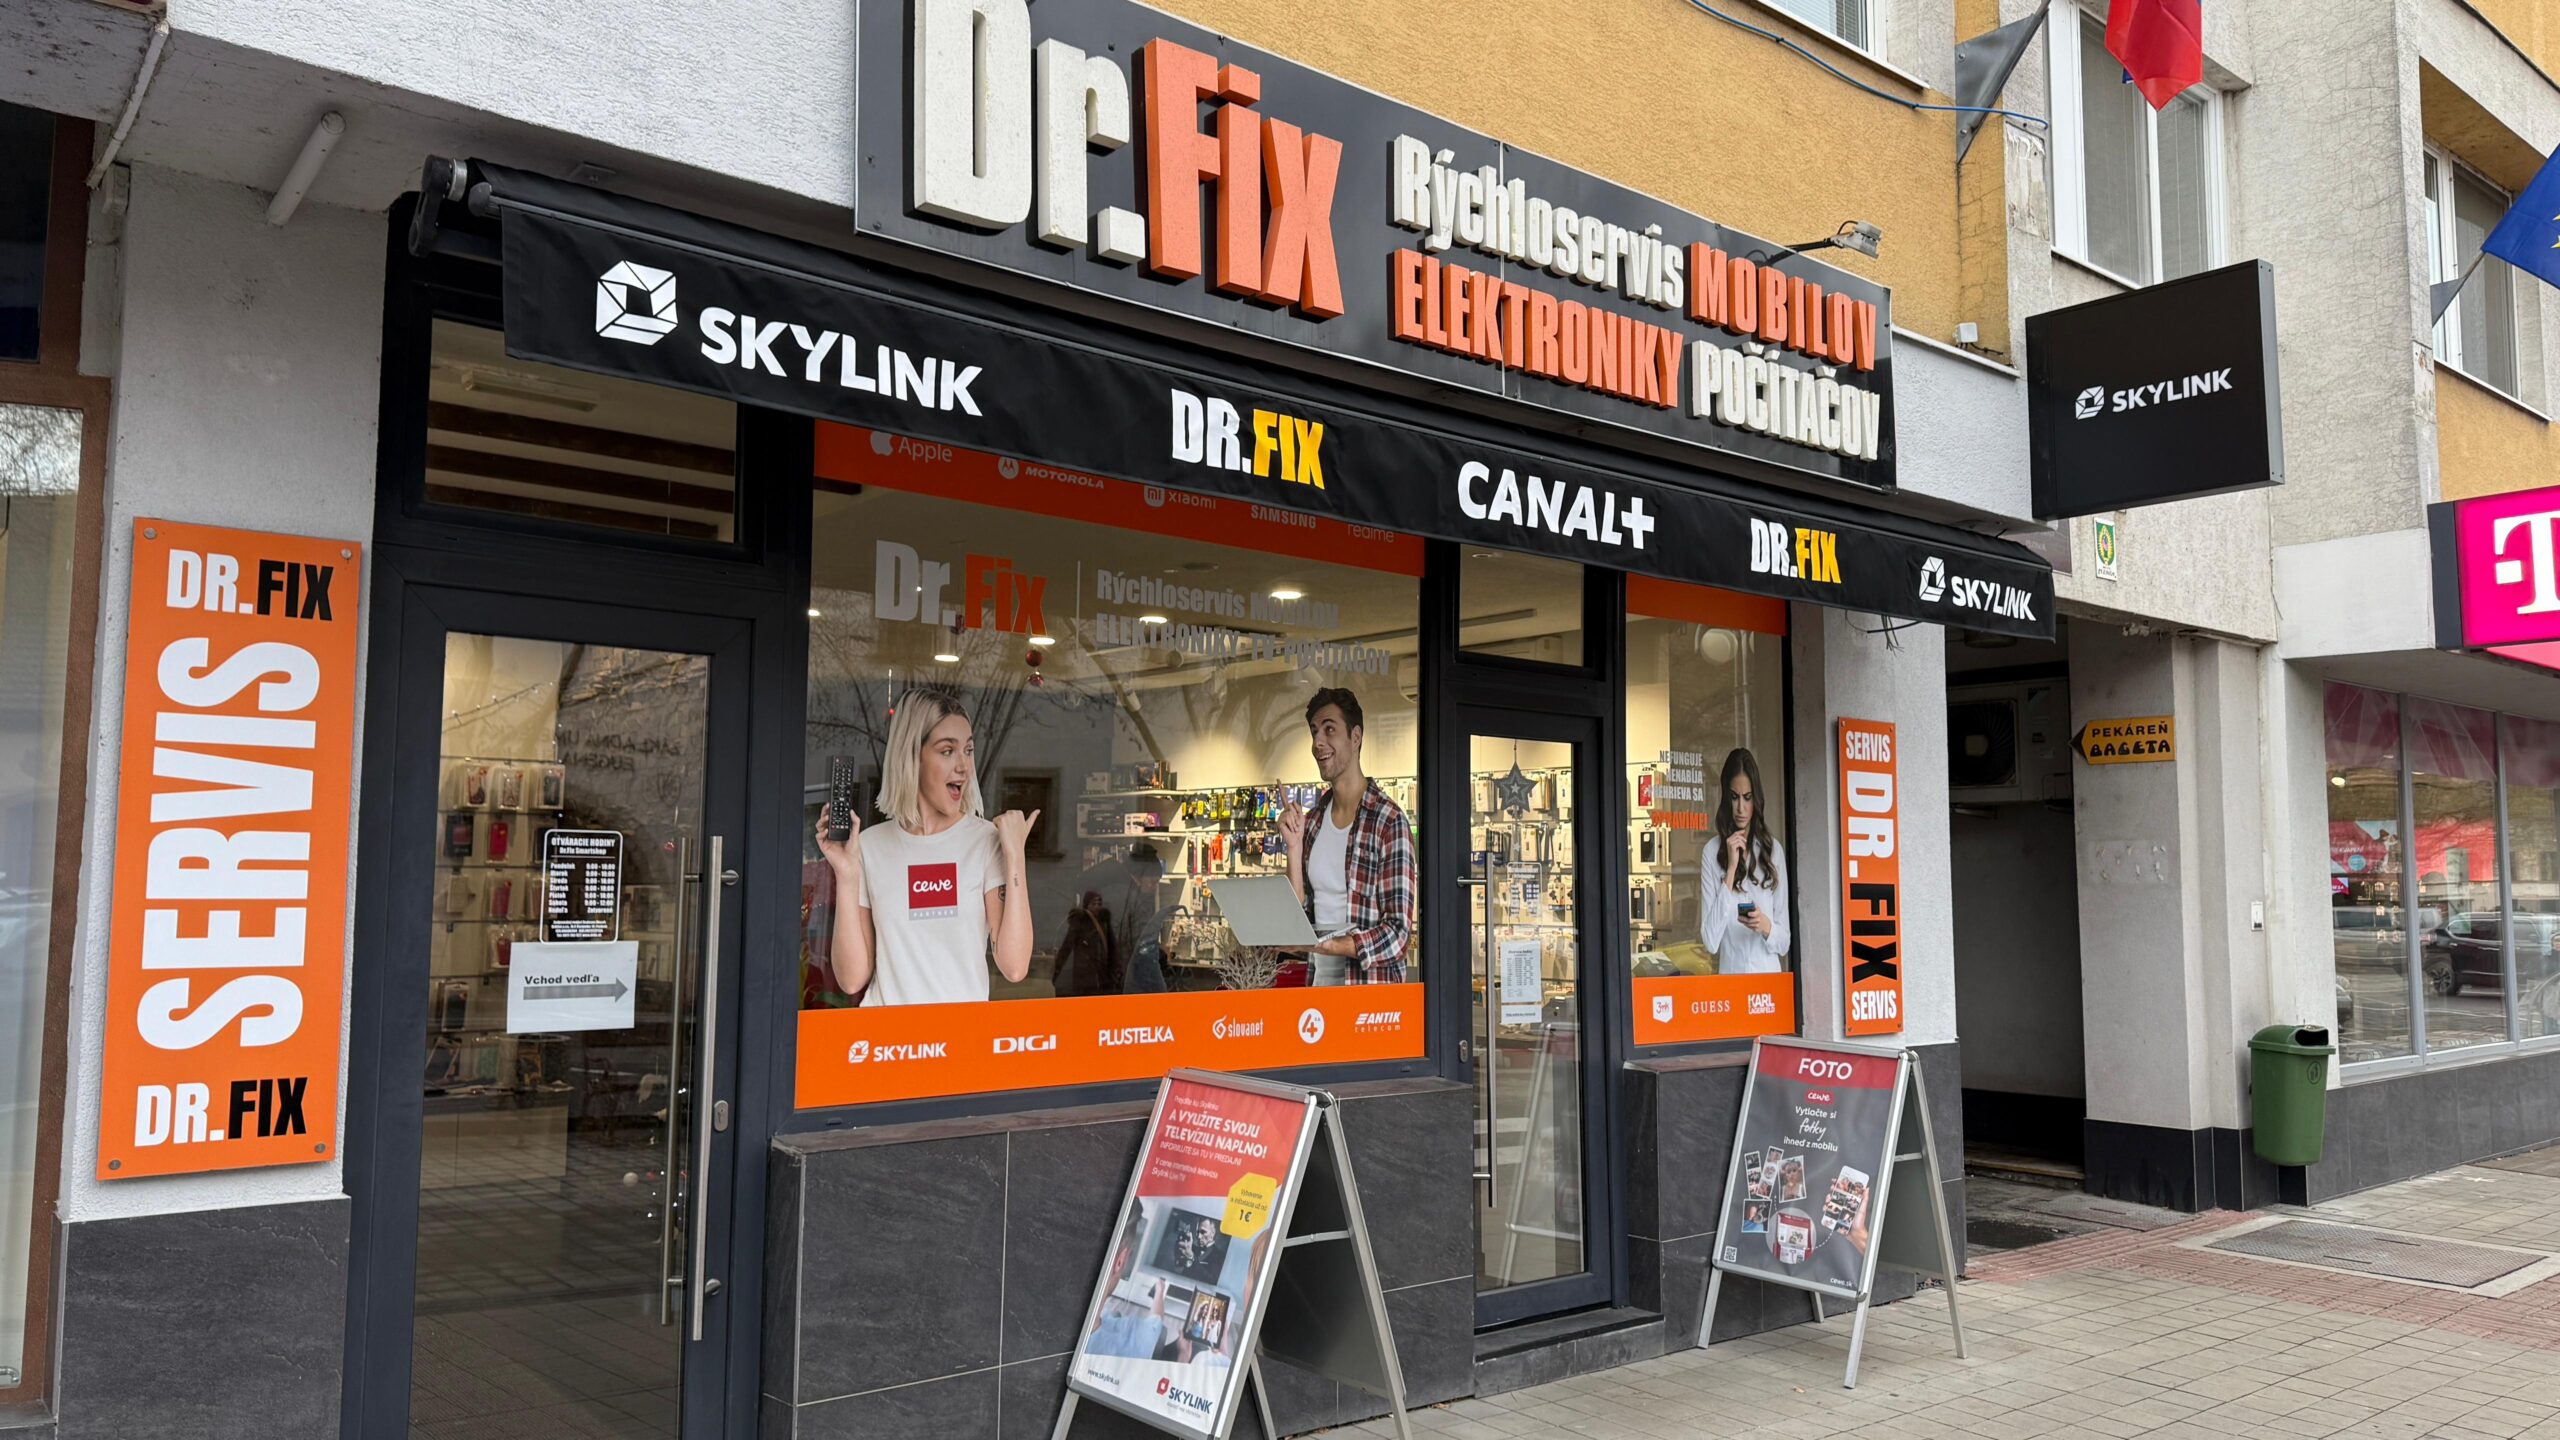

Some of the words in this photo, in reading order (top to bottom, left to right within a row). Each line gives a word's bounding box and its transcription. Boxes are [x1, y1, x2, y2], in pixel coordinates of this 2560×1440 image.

[914, 0, 1344, 319] Dr.Fix
[1393, 133, 1684, 310] Rýchloservis
[1689, 241, 1876, 372] MOBILOV
[699, 306, 983, 416] SKYLINK
[1393, 247, 1684, 409] ELEKTRONIKY
[1692, 339, 1880, 462] POČÍTAČOV
[2111, 367, 2233, 413] SKYLINK
[900, 437, 953, 463] Apple
[1171, 388, 1325, 490] DR.FIX
[1025, 466, 1105, 489] MOTOROLA
[1251, 504, 1317, 529] SAMSUNG
[1457, 460, 1655, 549] CANAL+
[1348, 523, 1394, 543] realme
[1750, 517, 1842, 584] DR.FIX
[166, 549, 333, 621] DR.FIX
[874, 540, 1048, 636] Dr.Fix
[1097, 569, 1245, 619] Rýchloservis
[1951, 575, 2037, 621] SKYLINK
[1096, 612, 1240, 658] ELEKTRONIKY
[1249, 632, 1276, 661] TV
[2091, 721, 2168, 738] PEKÁREŇ
[1660, 750, 1703, 767] NEFUNGUJE
[1845, 730, 1891, 763] SERVIS
[2090, 739, 2171, 757] BAGETA
[1666, 767, 1703, 784] NENABÍJA
[1692, 787, 1704, 802] SA
[137, 637, 320, 1050] SERVIS
[590, 838, 616, 847] HODINY
[913, 879, 953, 893] cewe
[1846, 770, 1898, 984] DR.FIX
[524, 975, 562, 985] Vchod
[566, 974, 600, 983] vedľa
[1691, 1000, 1731, 1014] GUESS
[1747, 993, 1775, 1007] KARL
[1851, 989, 1897, 1021] SERVIS
[1228, 1017, 1264, 1038] slovanet
[1354, 1024, 1401, 1033] telecom
[1366, 1011, 1401, 1024] ANTIK
[992, 1034, 1057, 1054] DIGI
[1098, 1025, 1175, 1046] PLUSTELKA
[873, 1042, 947, 1062] SKYLINK
[1798, 1057, 1853, 1080] FOTO
[1807, 1092, 1830, 1102] cewe
[135, 1076, 307, 1147] DR.FIX
[1169, 1109, 1176, 1121] A
[1178, 1110, 1223, 1131] VYUŽITE
[1222, 1119, 1260, 1138] SVOJU
[1795, 1105, 1828, 1118] Vytlačte
[1830, 1110, 1837, 1119] si
[1165, 1124, 1215, 1147] TELEVÍZIU
[1215, 1135, 1268, 1159] NAPLNO!
[1798, 1117, 1827, 1142] fotky
[1783, 1136, 1806, 1147] ihneď
[1811, 1140, 1838, 1152] mobilu
[1168, 1386, 1213, 1414] SKYLINK
